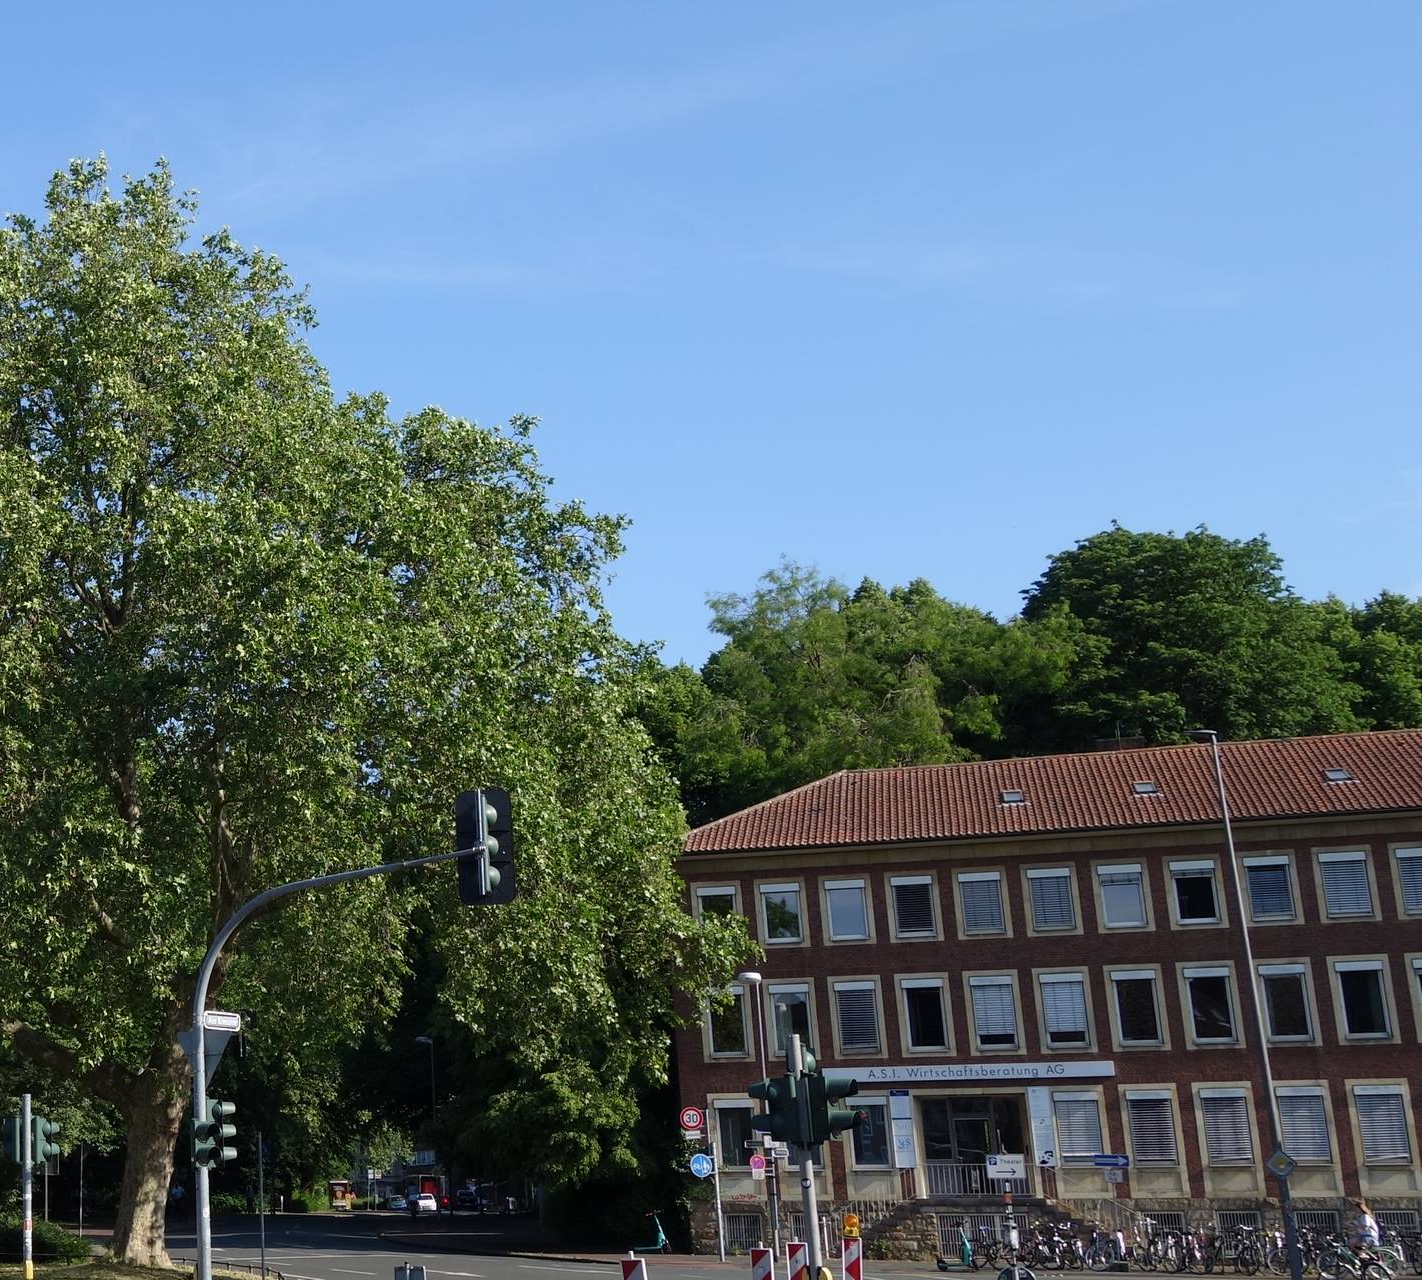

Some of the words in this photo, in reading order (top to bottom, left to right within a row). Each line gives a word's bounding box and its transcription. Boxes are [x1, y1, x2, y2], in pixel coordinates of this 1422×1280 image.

[868, 1069, 900, 1080] A.S.I.
[906, 1065, 1039, 1079] Wirtschaftsberatung
[1045, 1063, 1065, 1076] AG
[685, 1113, 698, 1124] 30
